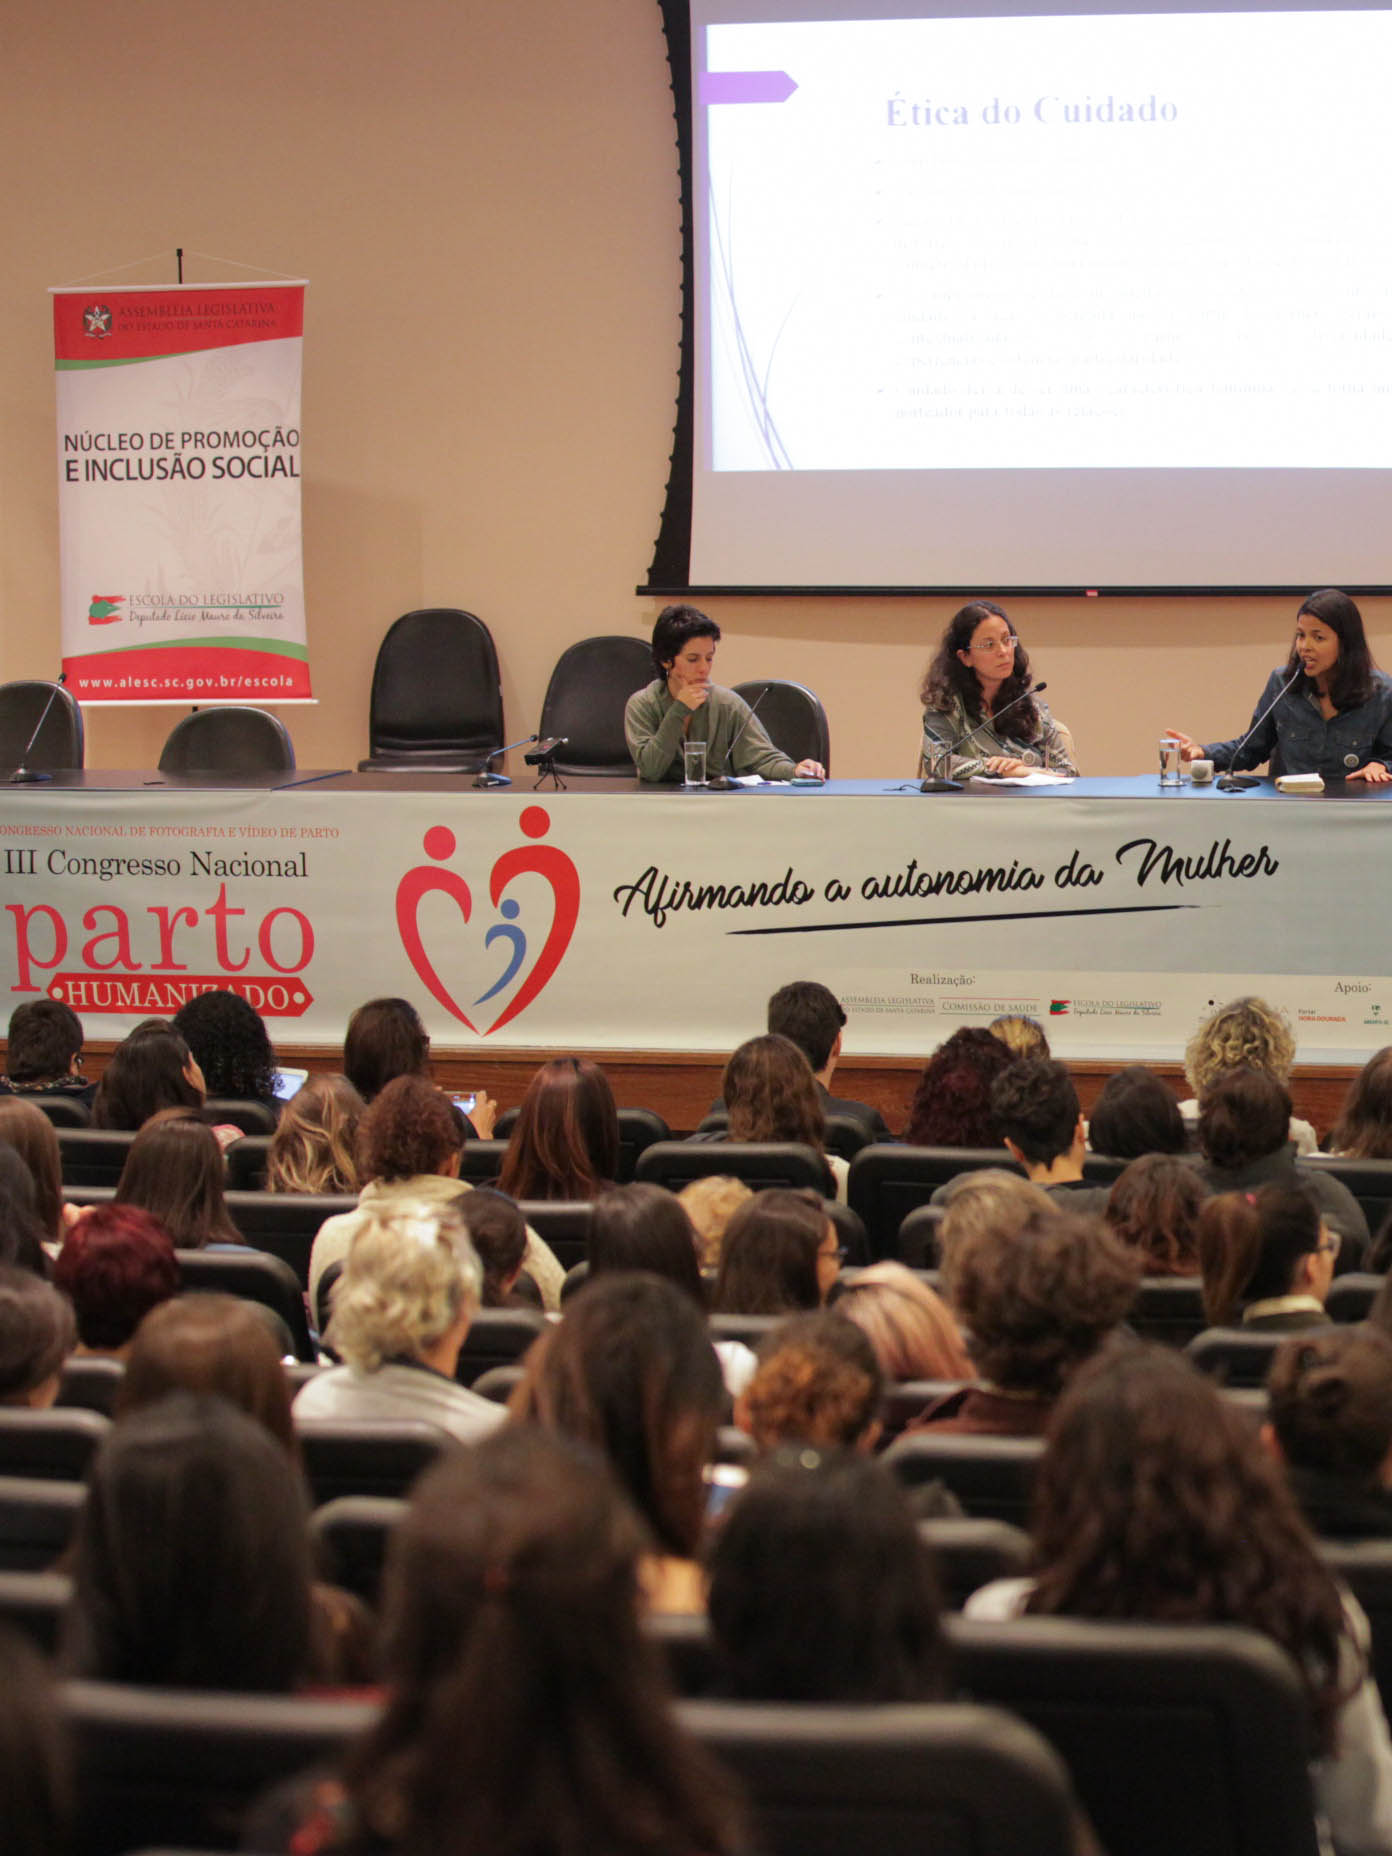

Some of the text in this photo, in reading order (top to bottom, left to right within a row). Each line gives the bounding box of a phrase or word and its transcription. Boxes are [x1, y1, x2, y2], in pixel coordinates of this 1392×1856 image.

[887, 90, 1178, 127] Ética do Cuidado
[64, 426, 300, 453] NÚCLEO DE PROMOÇÃO
[65, 452, 301, 482] E INCLUSÃO SOCIAL
[129, 592, 285, 607] ESCOLA DO LEGISLATIVO
[129, 609, 171, 627] Deputado
[232, 608, 245, 621] da
[78, 675, 294, 691] www.alesc.sc.gov.br/escola
[0, 824, 62, 837] ONGRESSO
[65, 825, 127, 838] NACIONAL
[130, 826, 147, 838] DE
[149, 826, 226, 839] FOTOGRAFIA
[228, 826, 237, 838] E
[280, 827, 298, 839] DE
[300, 827, 340, 839] PARTO
[4, 849, 309, 882] III Congresso Nacional
[613, 838, 1280, 928] Afirmando a autonomia da Mulher
[4, 882, 315, 992] parto
[910, 972, 977, 988] Realização:
[1334, 981, 1372, 995] Apoio:
